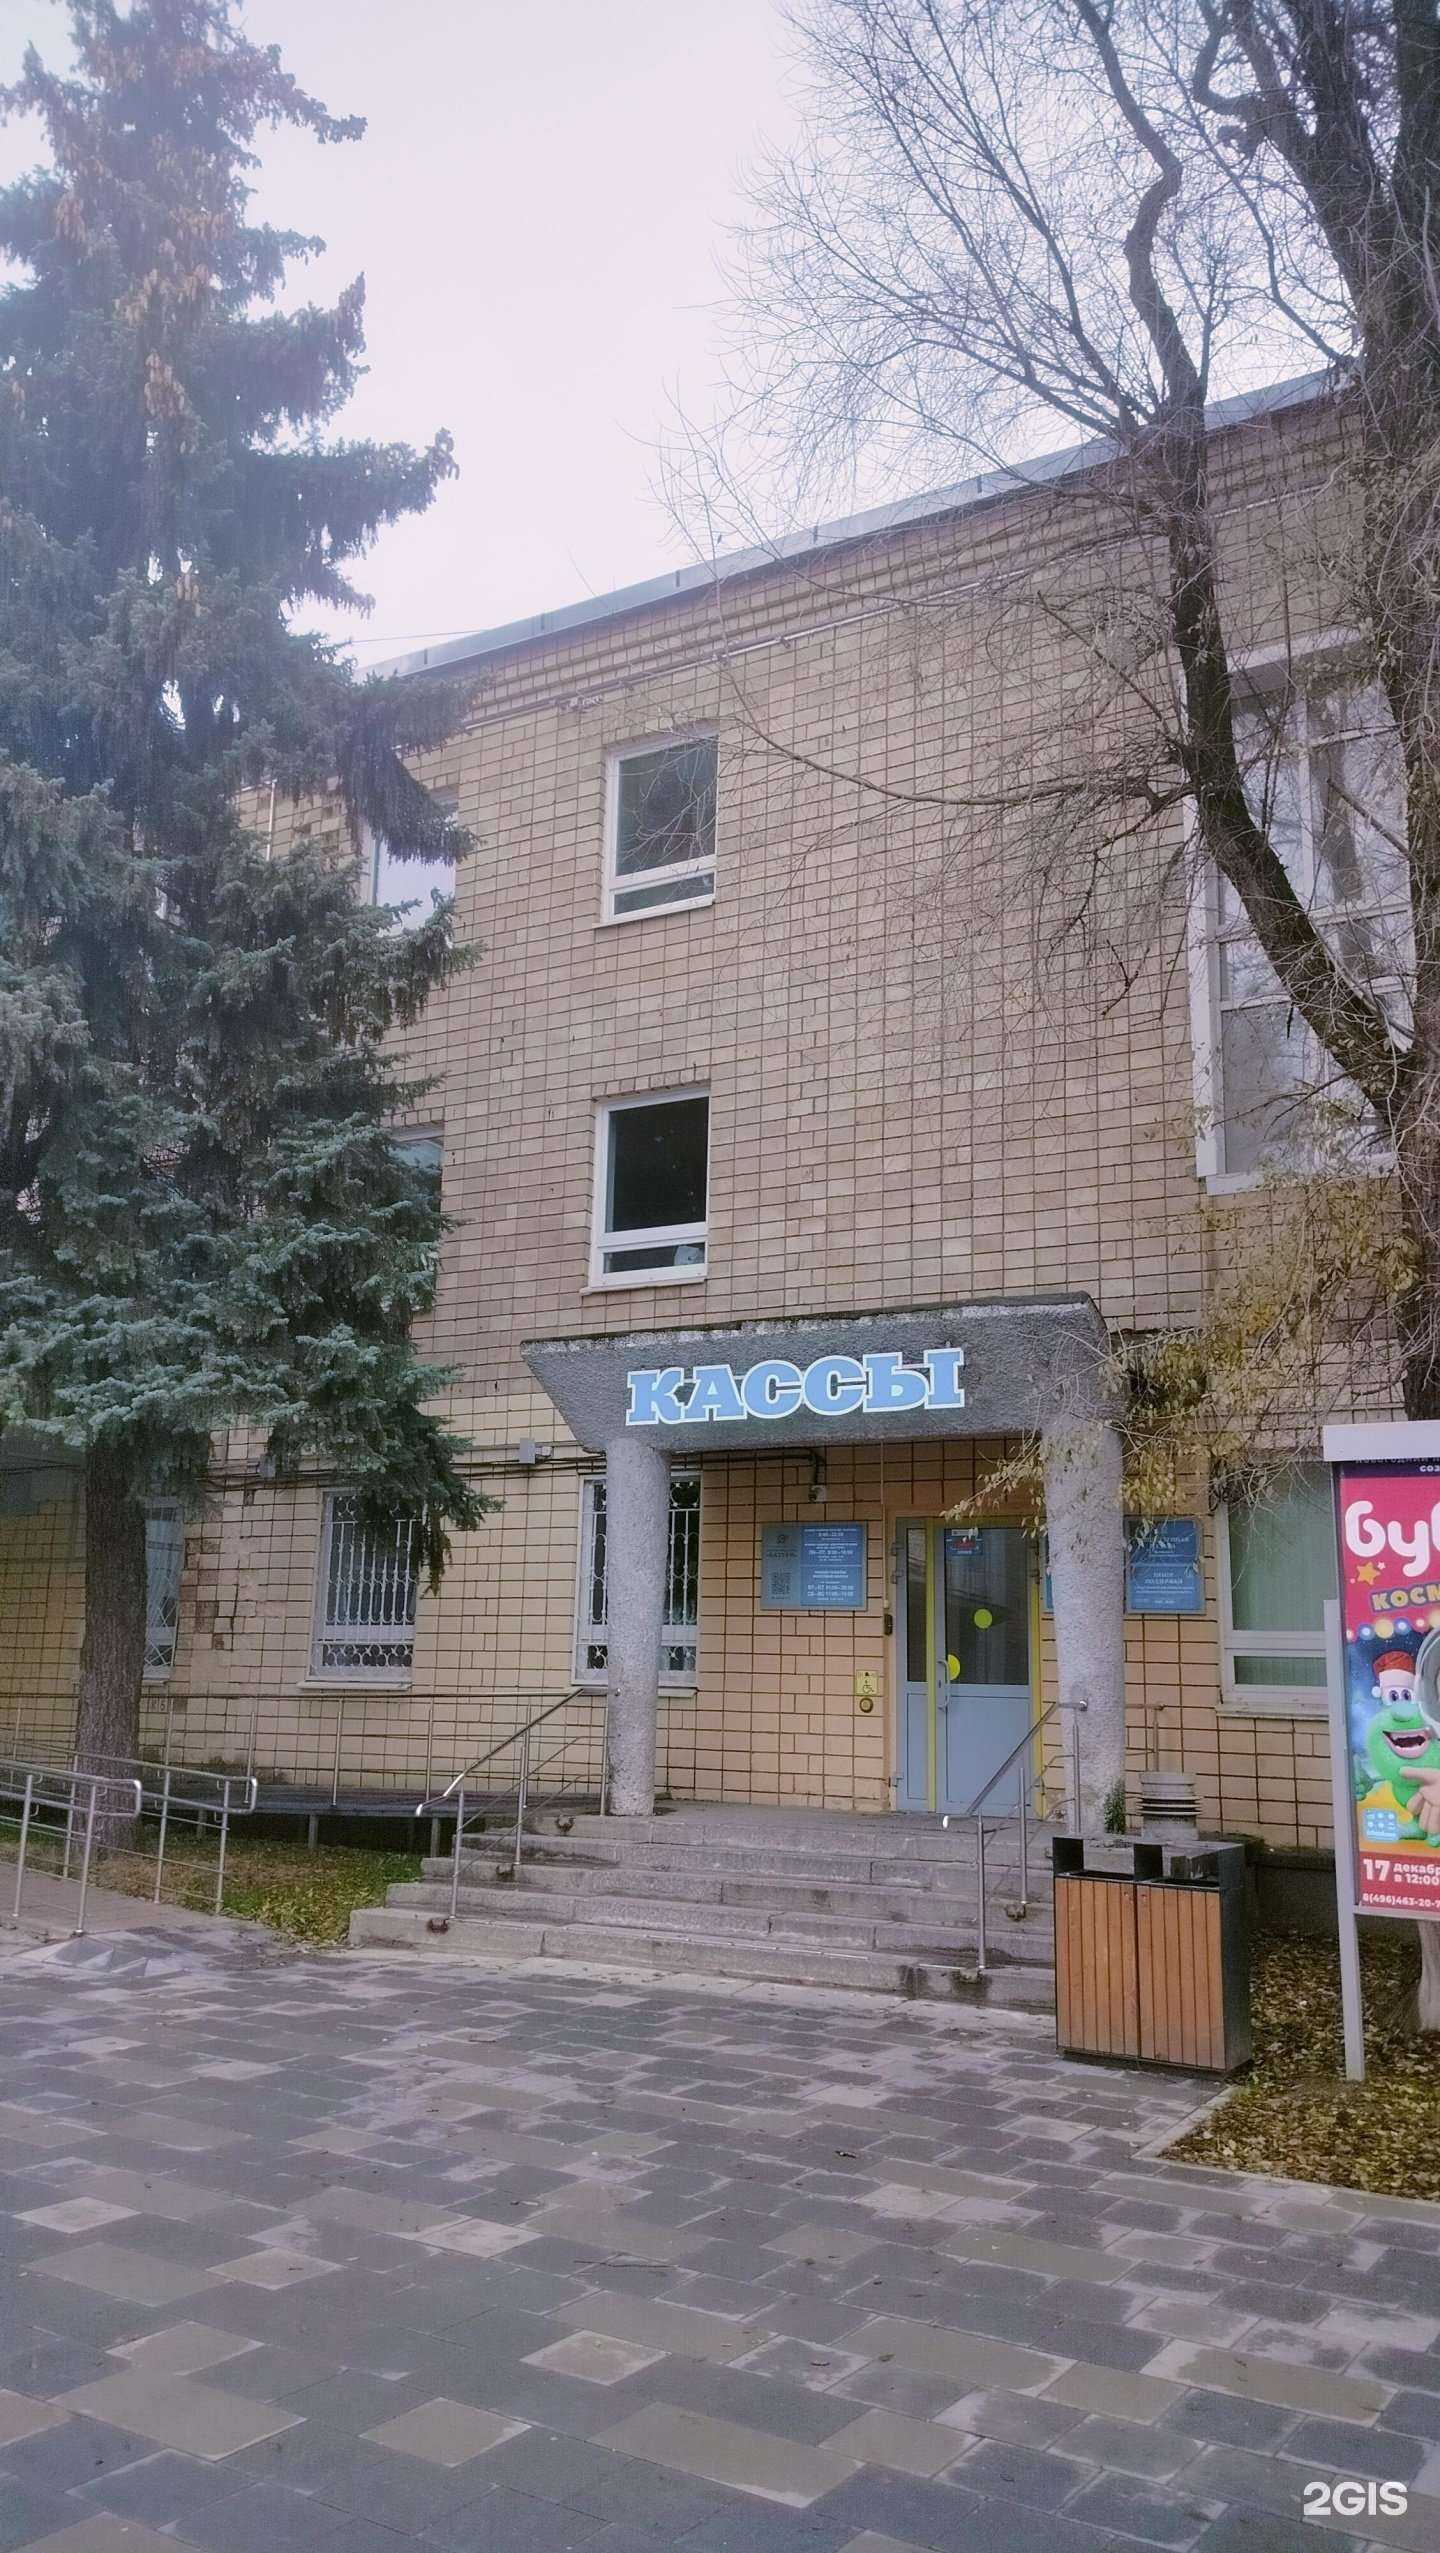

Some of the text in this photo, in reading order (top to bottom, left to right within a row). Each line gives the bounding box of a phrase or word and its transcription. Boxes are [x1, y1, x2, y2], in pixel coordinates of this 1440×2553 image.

[625, 1347, 965, 1426] КАССЫ
[1363, 1859, 1390, 1881] 17
[1405, 1874, 1440, 1886] 12:00
